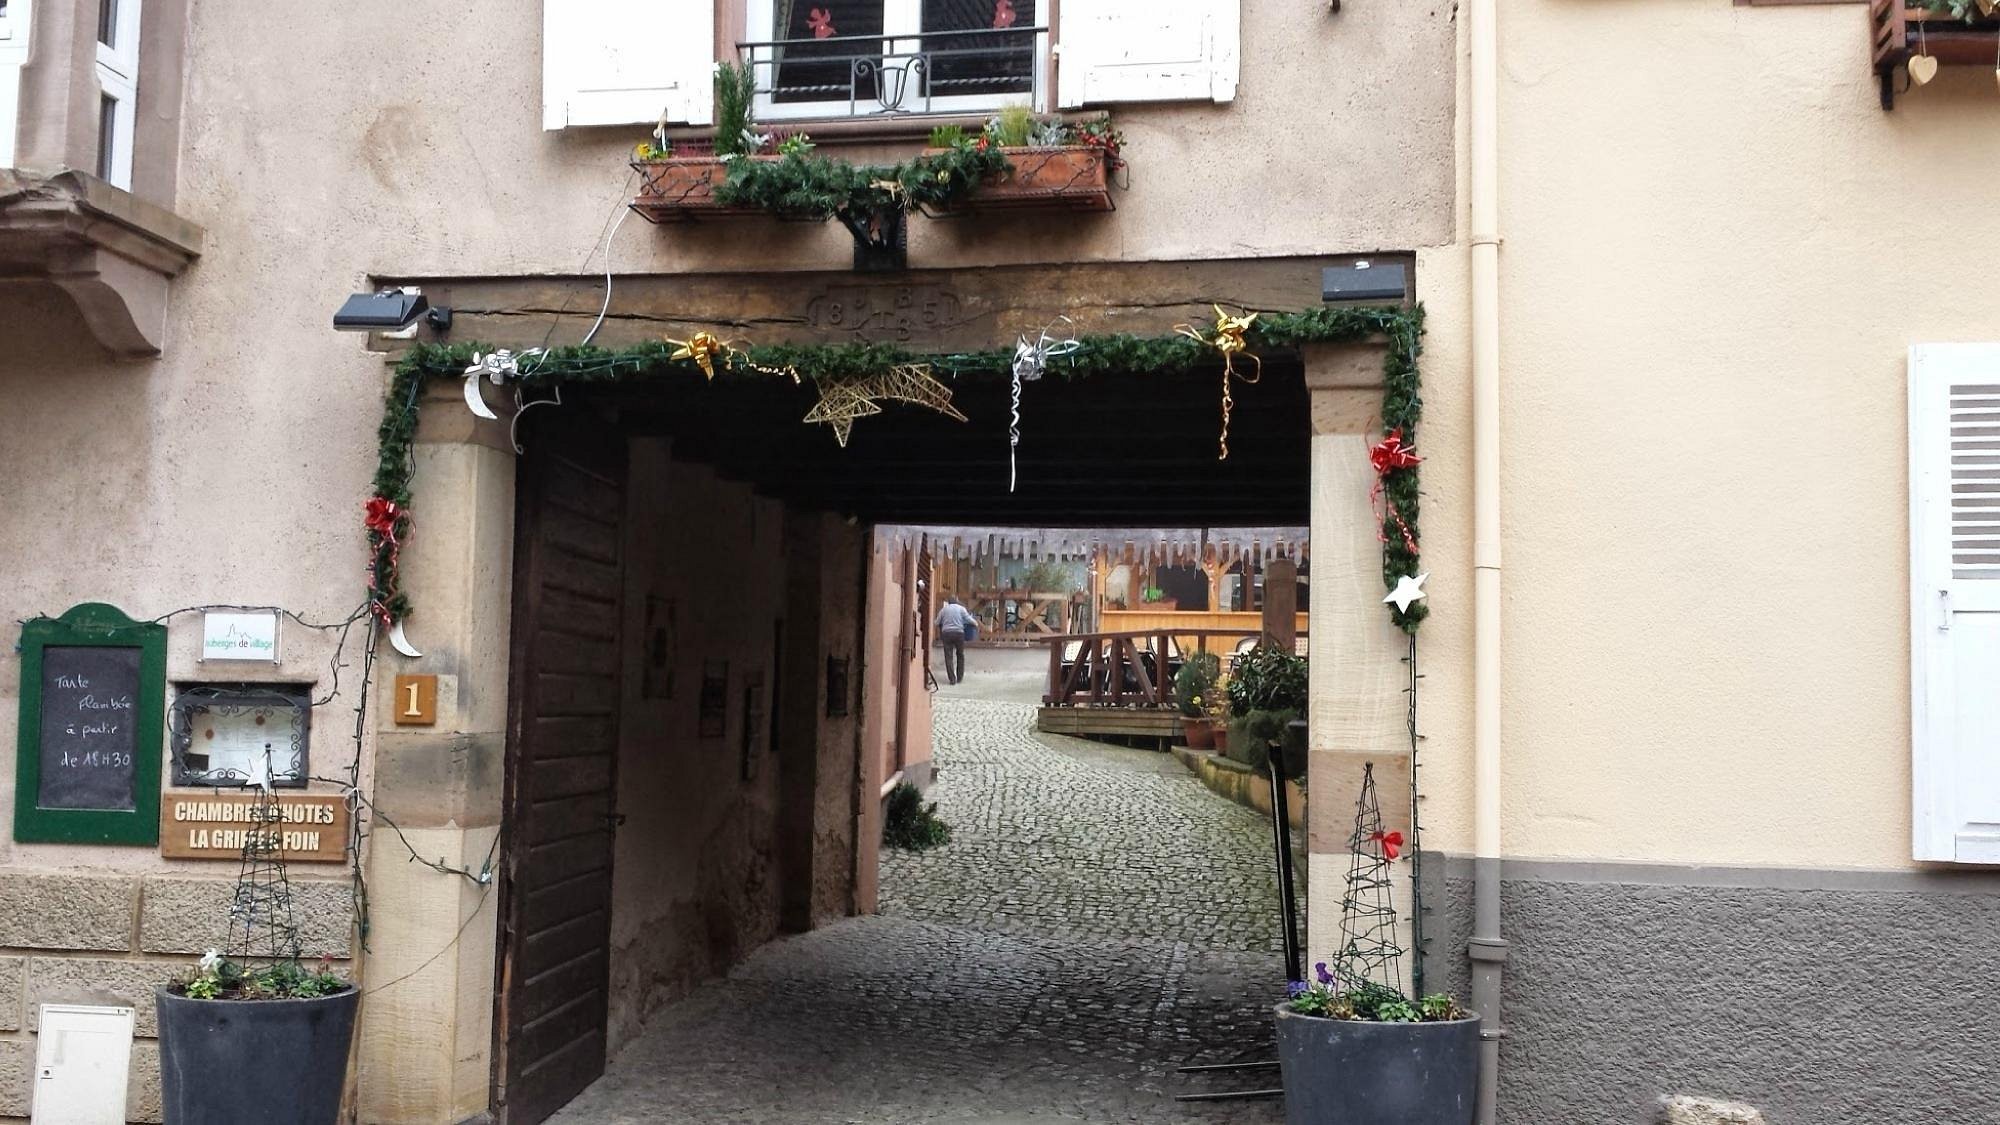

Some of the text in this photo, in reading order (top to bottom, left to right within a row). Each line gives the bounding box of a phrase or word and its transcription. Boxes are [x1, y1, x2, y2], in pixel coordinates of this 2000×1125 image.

[205, 637, 273, 651] auberges de village
[403, 682, 422, 716] 1
[66, 722, 117, 738] à partir
[61, 751, 78, 767] de
[189, 829, 209, 849] LA
[282, 830, 320, 851] FOIN
